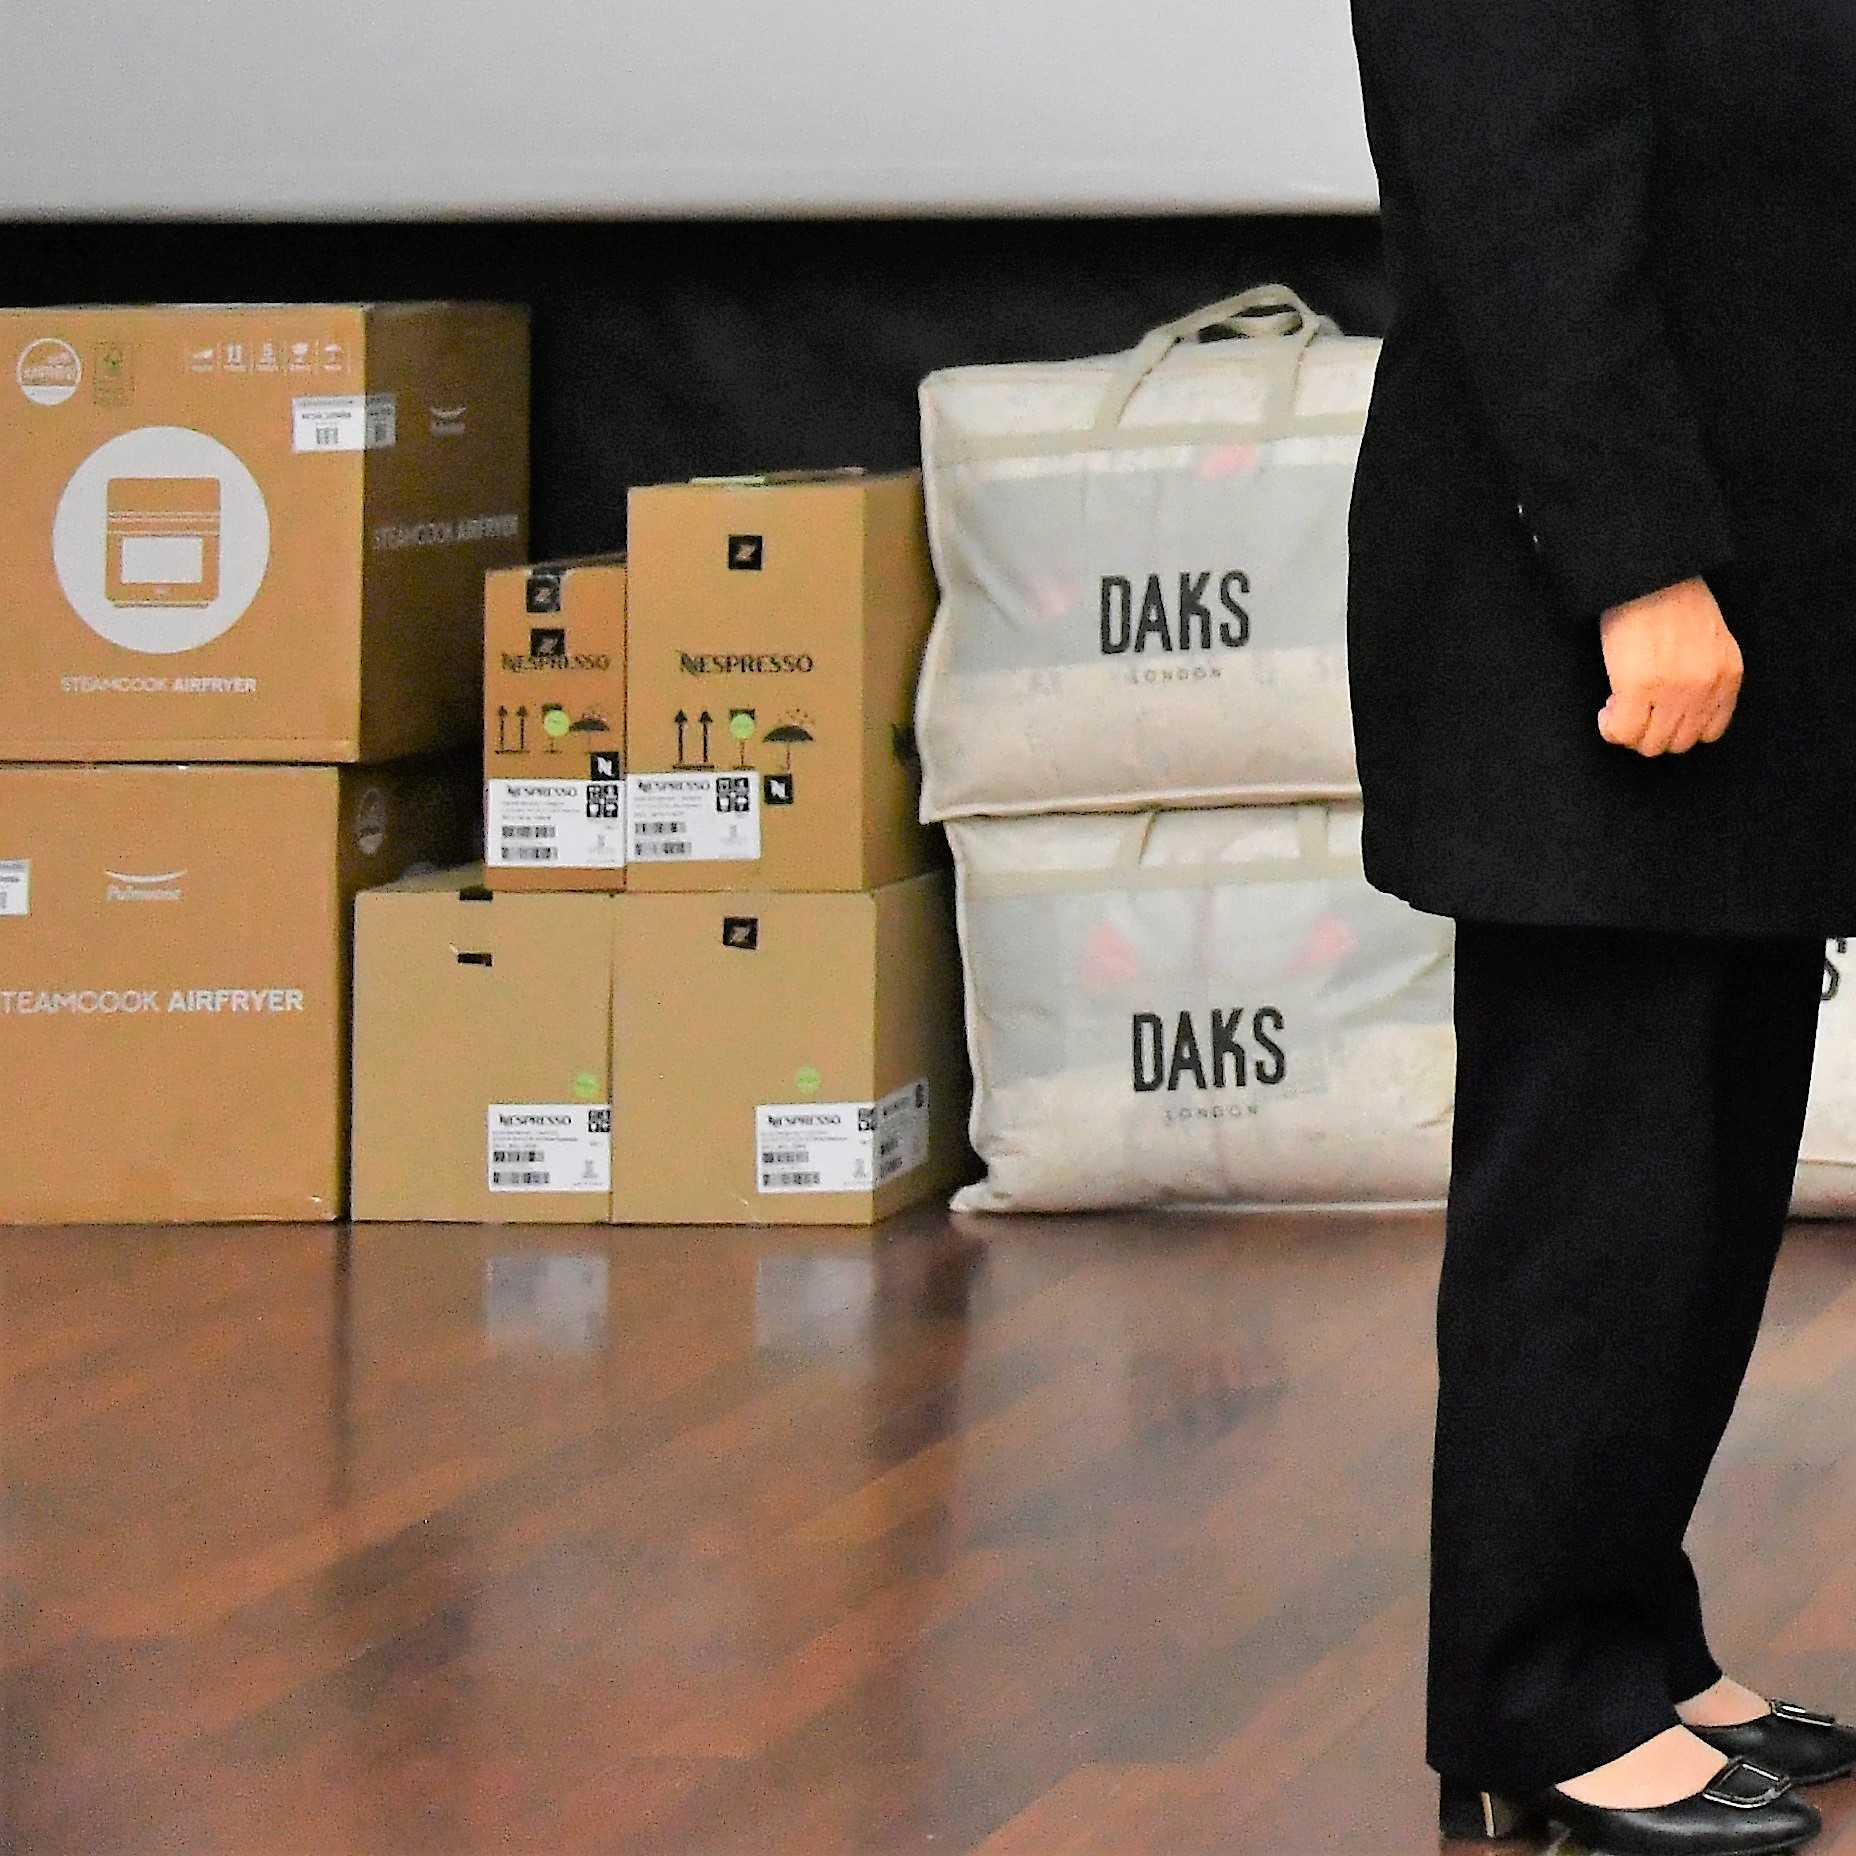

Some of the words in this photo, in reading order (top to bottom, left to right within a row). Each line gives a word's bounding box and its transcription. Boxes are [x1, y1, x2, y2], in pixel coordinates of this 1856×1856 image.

[1099, 569, 1251, 655] DAKS
[678, 651, 814, 675] NESPRESSO
[174, 676, 257, 694] AIRFRYER
[1131, 666, 1223, 685] LONDON
[0, 990, 158, 1013] TEAMCOOK
[168, 989, 303, 1012] AIRFRYER
[1132, 1006, 1286, 1092] DAKS
[1164, 1105, 1259, 1123] LONDON
